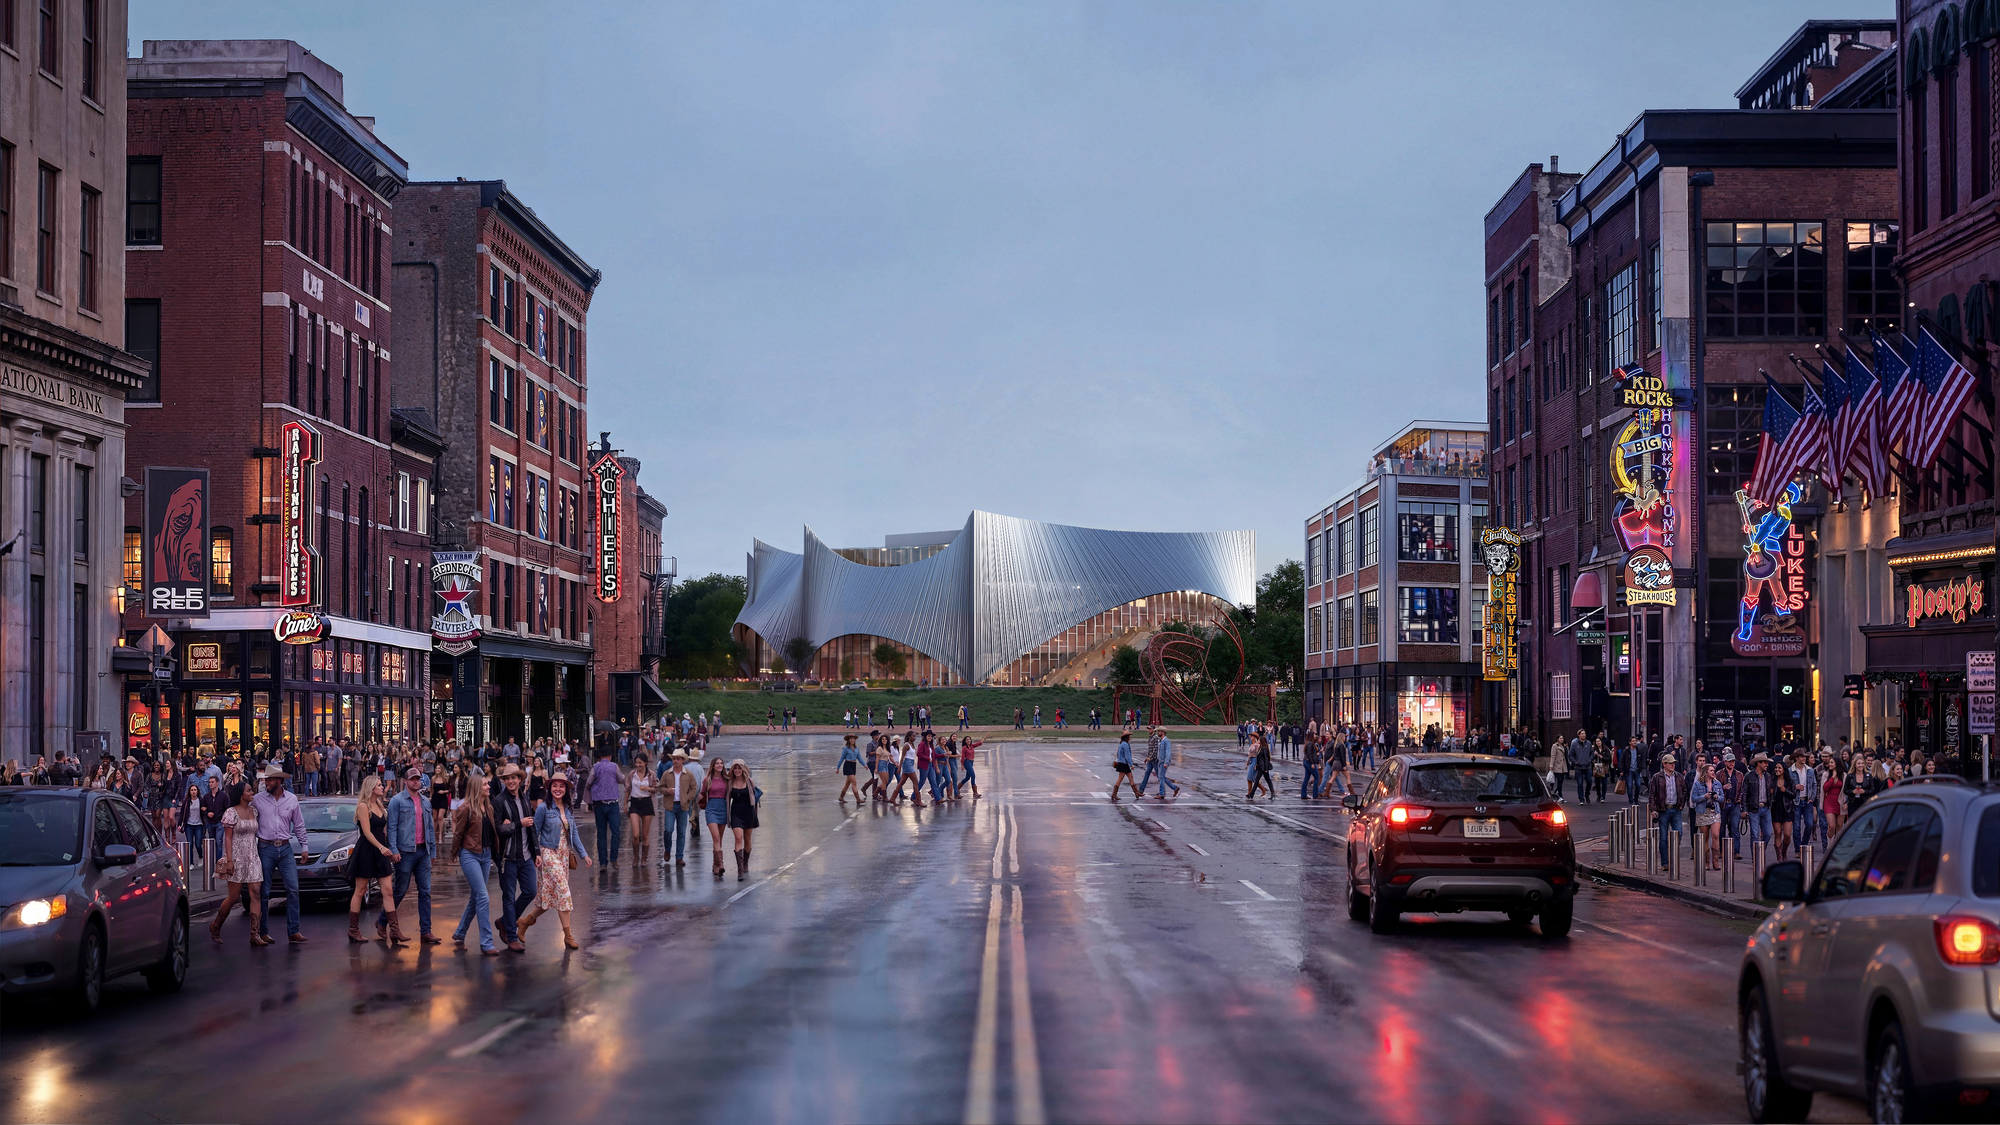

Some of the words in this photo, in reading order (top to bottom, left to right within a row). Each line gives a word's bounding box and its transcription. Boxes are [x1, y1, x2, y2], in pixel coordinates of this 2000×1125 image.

[1, 366, 64, 402] ATIONAL
[69, 387, 103, 414] BANK
[1632, 376, 1662, 391] KID
[1634, 437, 1659, 453] BIG
[1661, 408, 1673, 480] HONKY
[291, 428, 300, 519] RAISING
[1662, 489, 1674, 547] TONK
[601, 478, 617, 590] CHIEFS
[290, 525, 299, 597] CANES
[1628, 555, 1671, 573] Rock
[434, 563, 475, 577] REDNECK
[1642, 573, 1672, 588] Roll
[152, 587, 204, 599] OLE
[1628, 590, 1673, 603] STEAKHOUSE
[152, 599, 204, 610] RED
[275, 612, 320, 642] Cane's
[435, 622, 474, 633] RIVIERA
[1760, 613, 1797, 634] 32
[193, 647, 215, 658] ONE
[1771, 643, 1802, 651] DRINKS
[190, 659, 218, 669] LOVE
